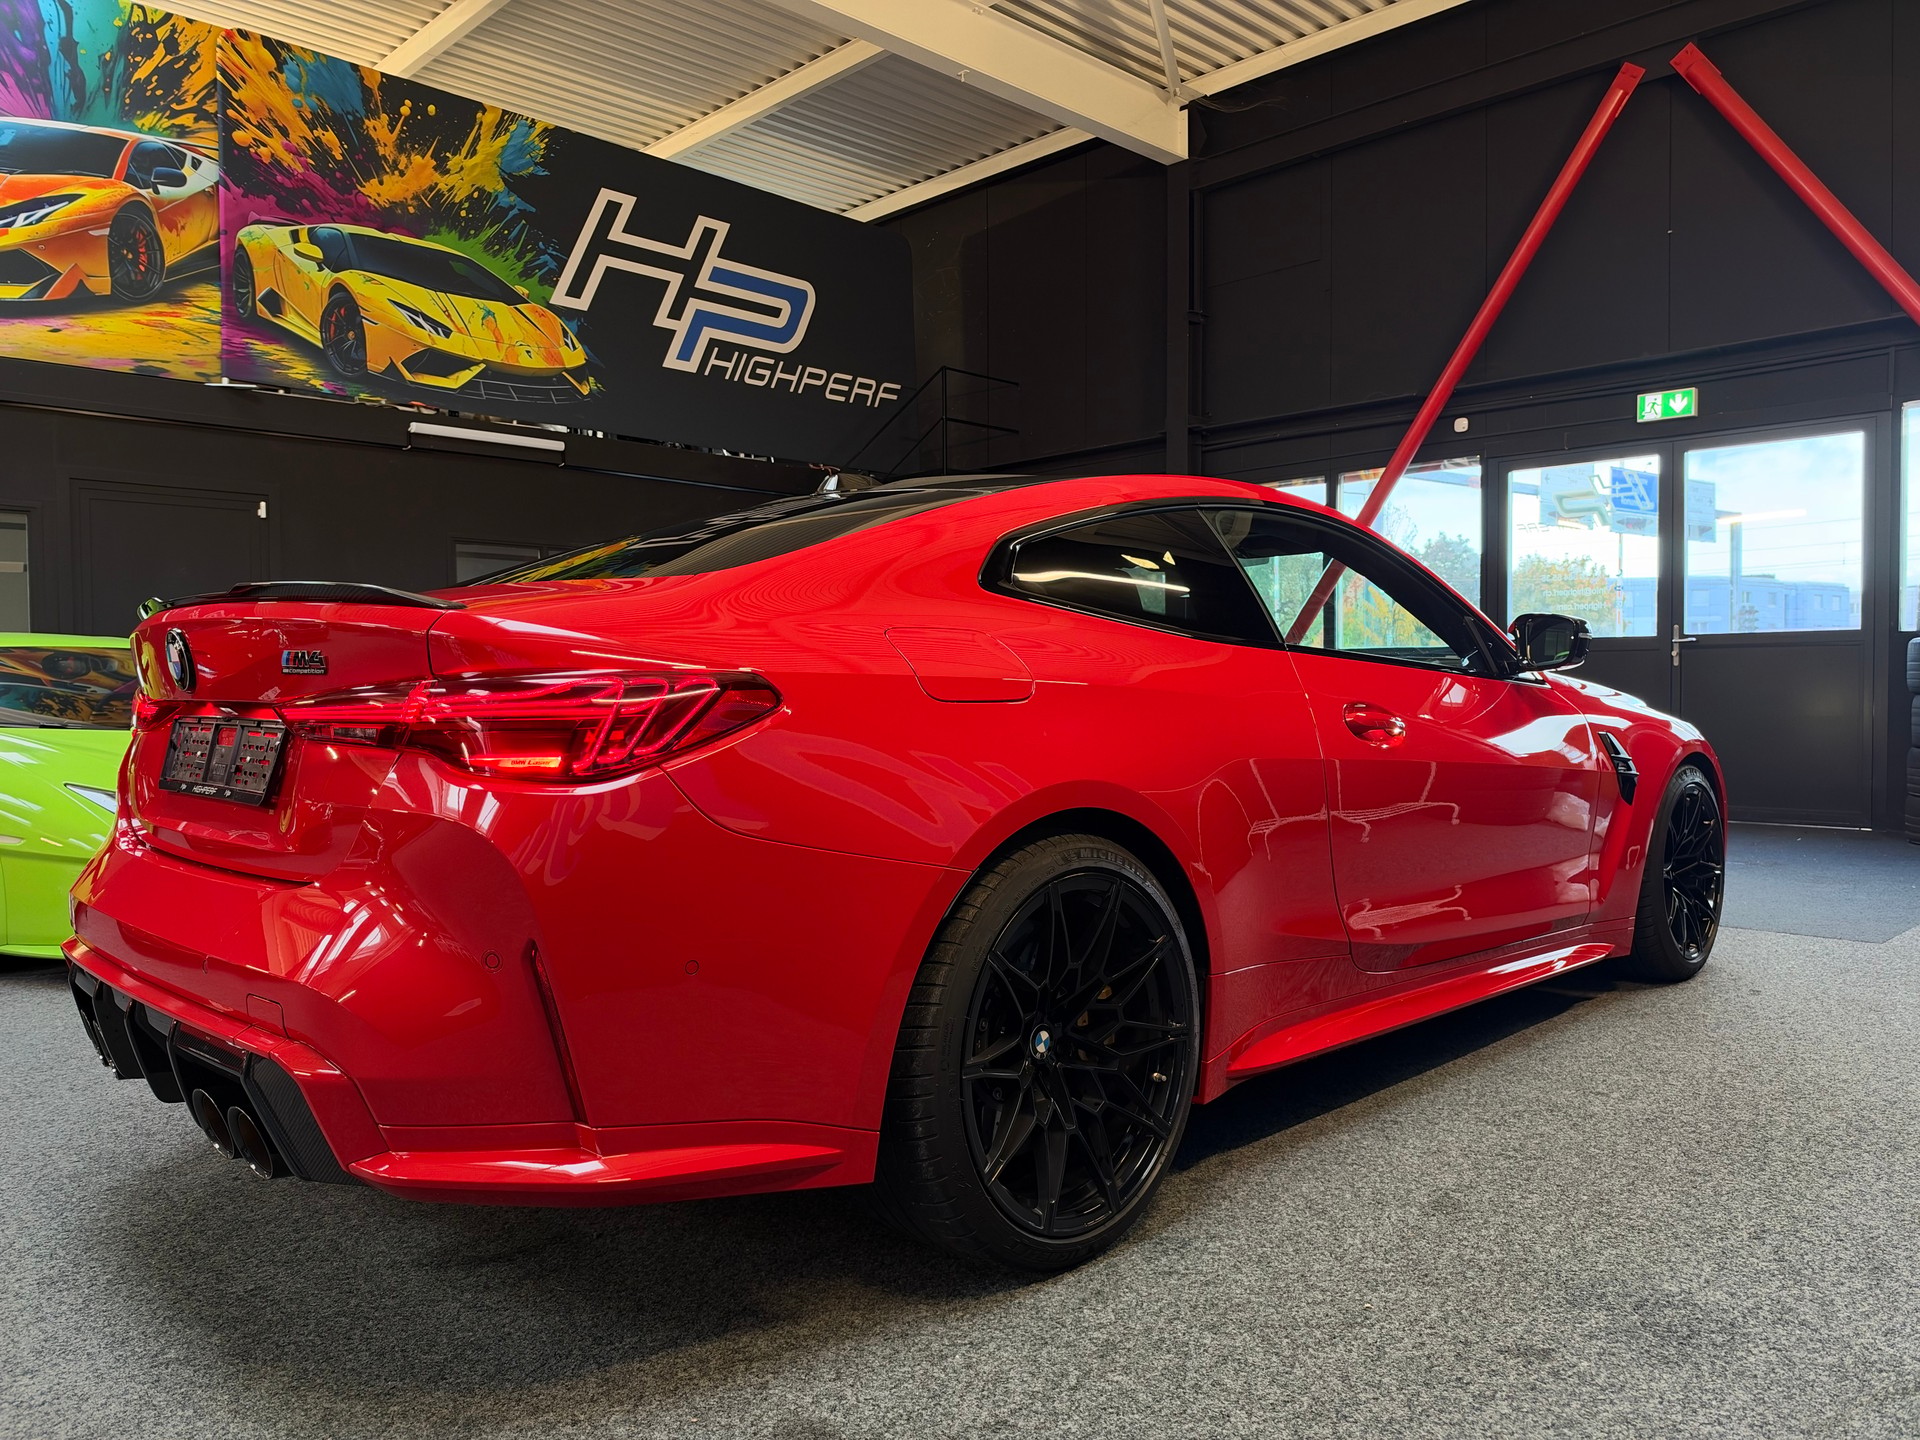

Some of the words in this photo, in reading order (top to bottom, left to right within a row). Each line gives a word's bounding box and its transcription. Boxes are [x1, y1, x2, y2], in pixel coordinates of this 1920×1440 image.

[704, 347, 902, 408] HIGHPERF
[283, 650, 326, 667] M4
[1080, 847, 1148, 880] MICHELIN
